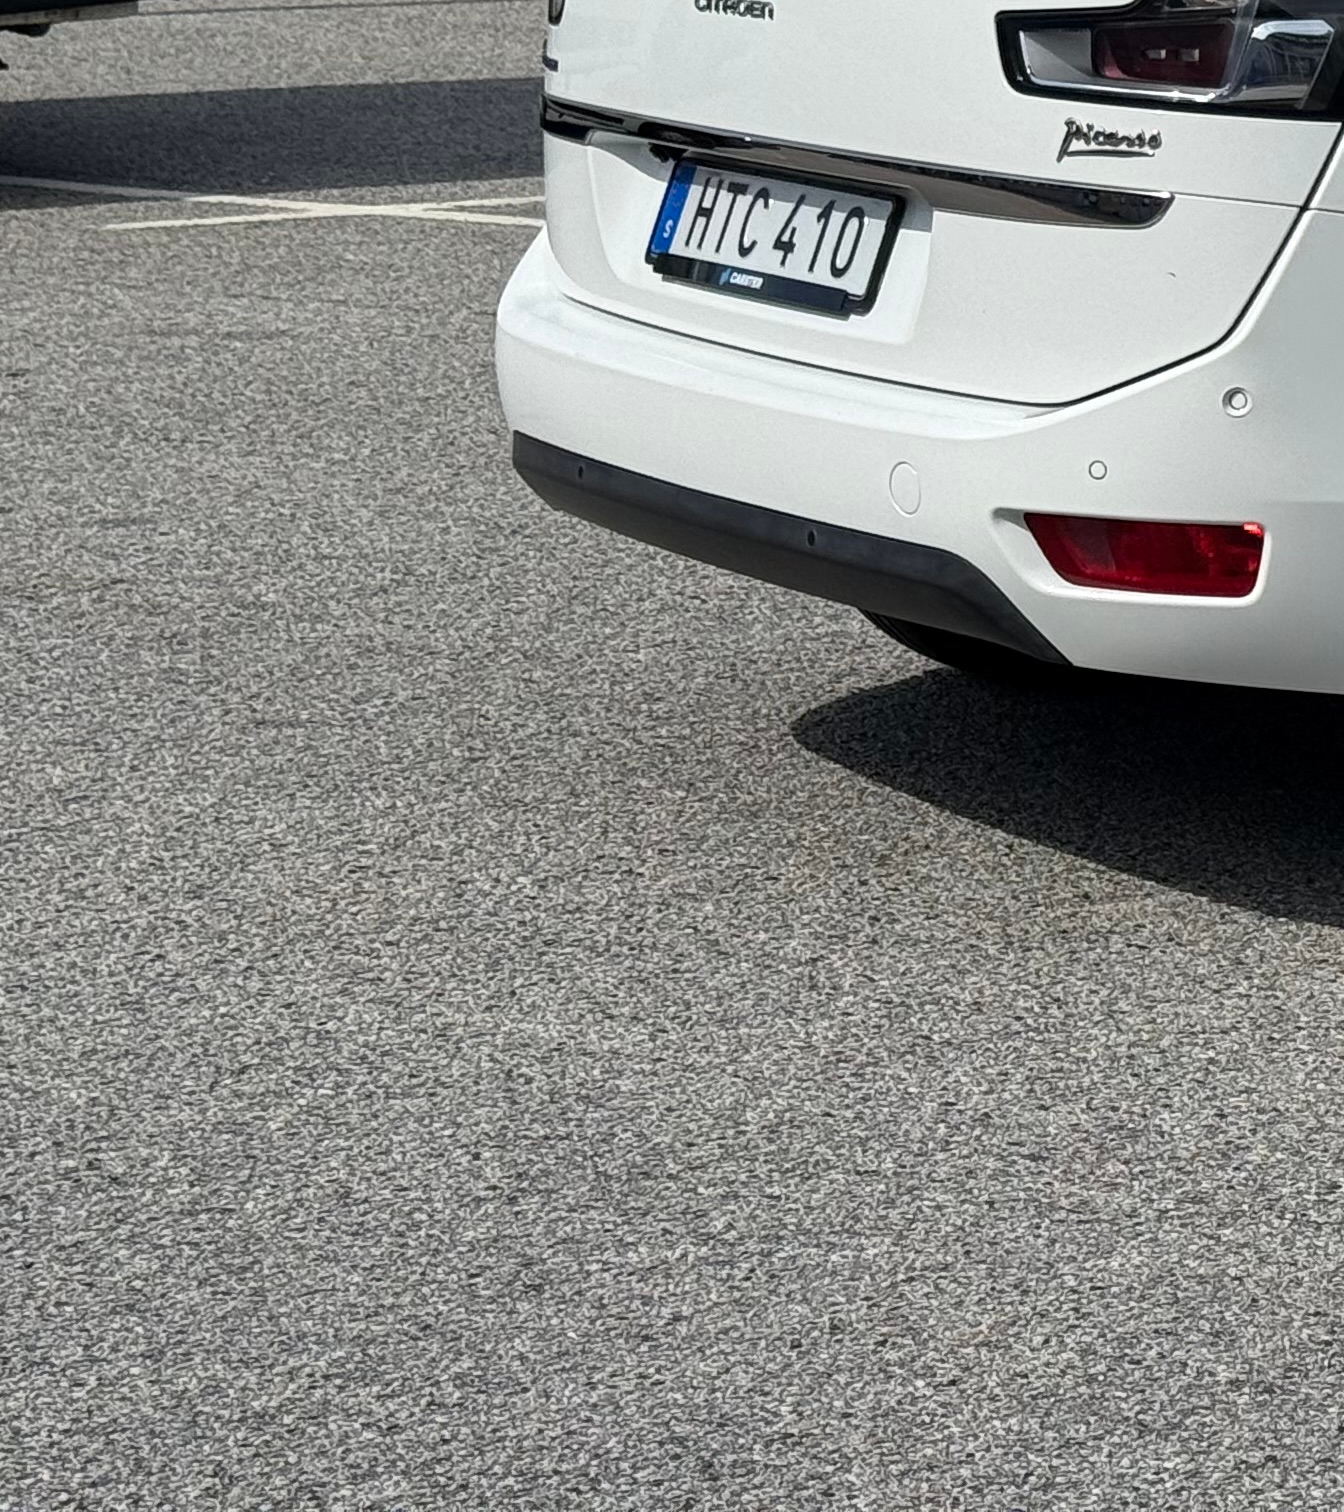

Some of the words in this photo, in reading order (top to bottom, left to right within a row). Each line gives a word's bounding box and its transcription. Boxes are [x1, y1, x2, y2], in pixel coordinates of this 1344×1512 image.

[662, 219, 674, 239] S
[685, 176, 771, 258] HTC
[772, 193, 866, 279] 410
